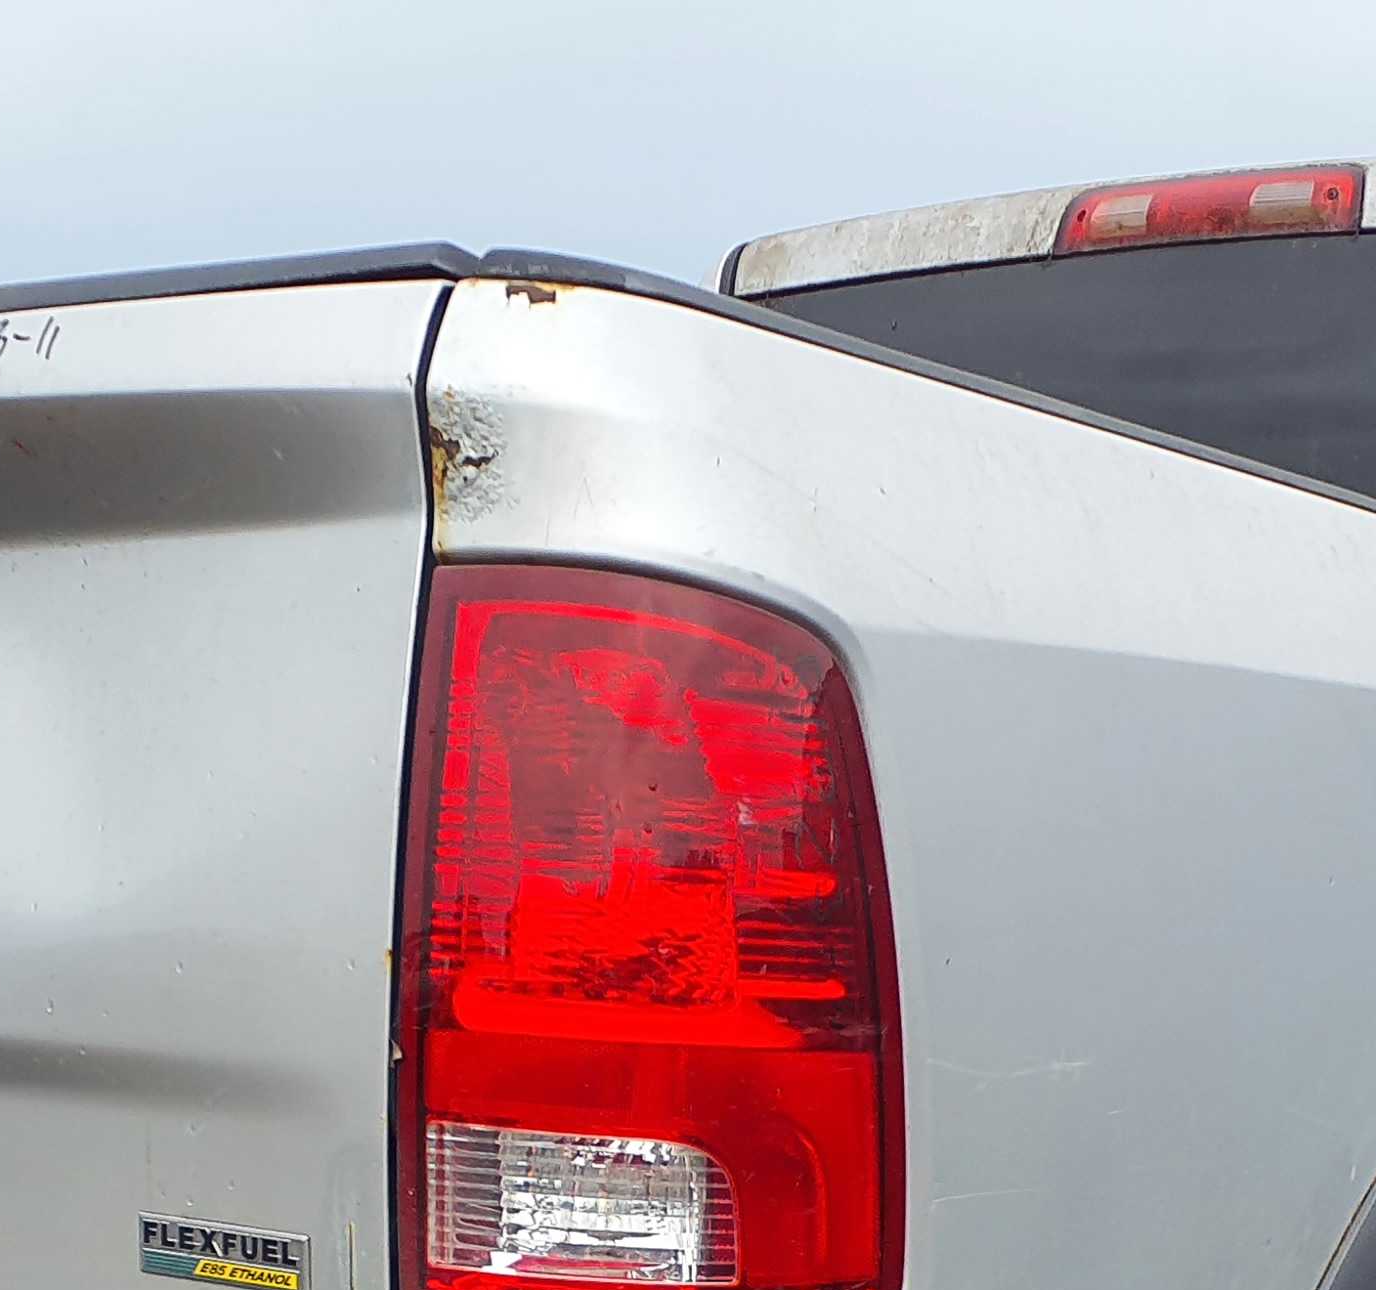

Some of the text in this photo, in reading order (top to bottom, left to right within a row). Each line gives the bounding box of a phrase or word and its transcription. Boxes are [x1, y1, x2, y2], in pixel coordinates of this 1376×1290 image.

[142, 1219, 300, 1267] FLEXFUEL
[200, 1262, 292, 1287] E85 ETHANOL
